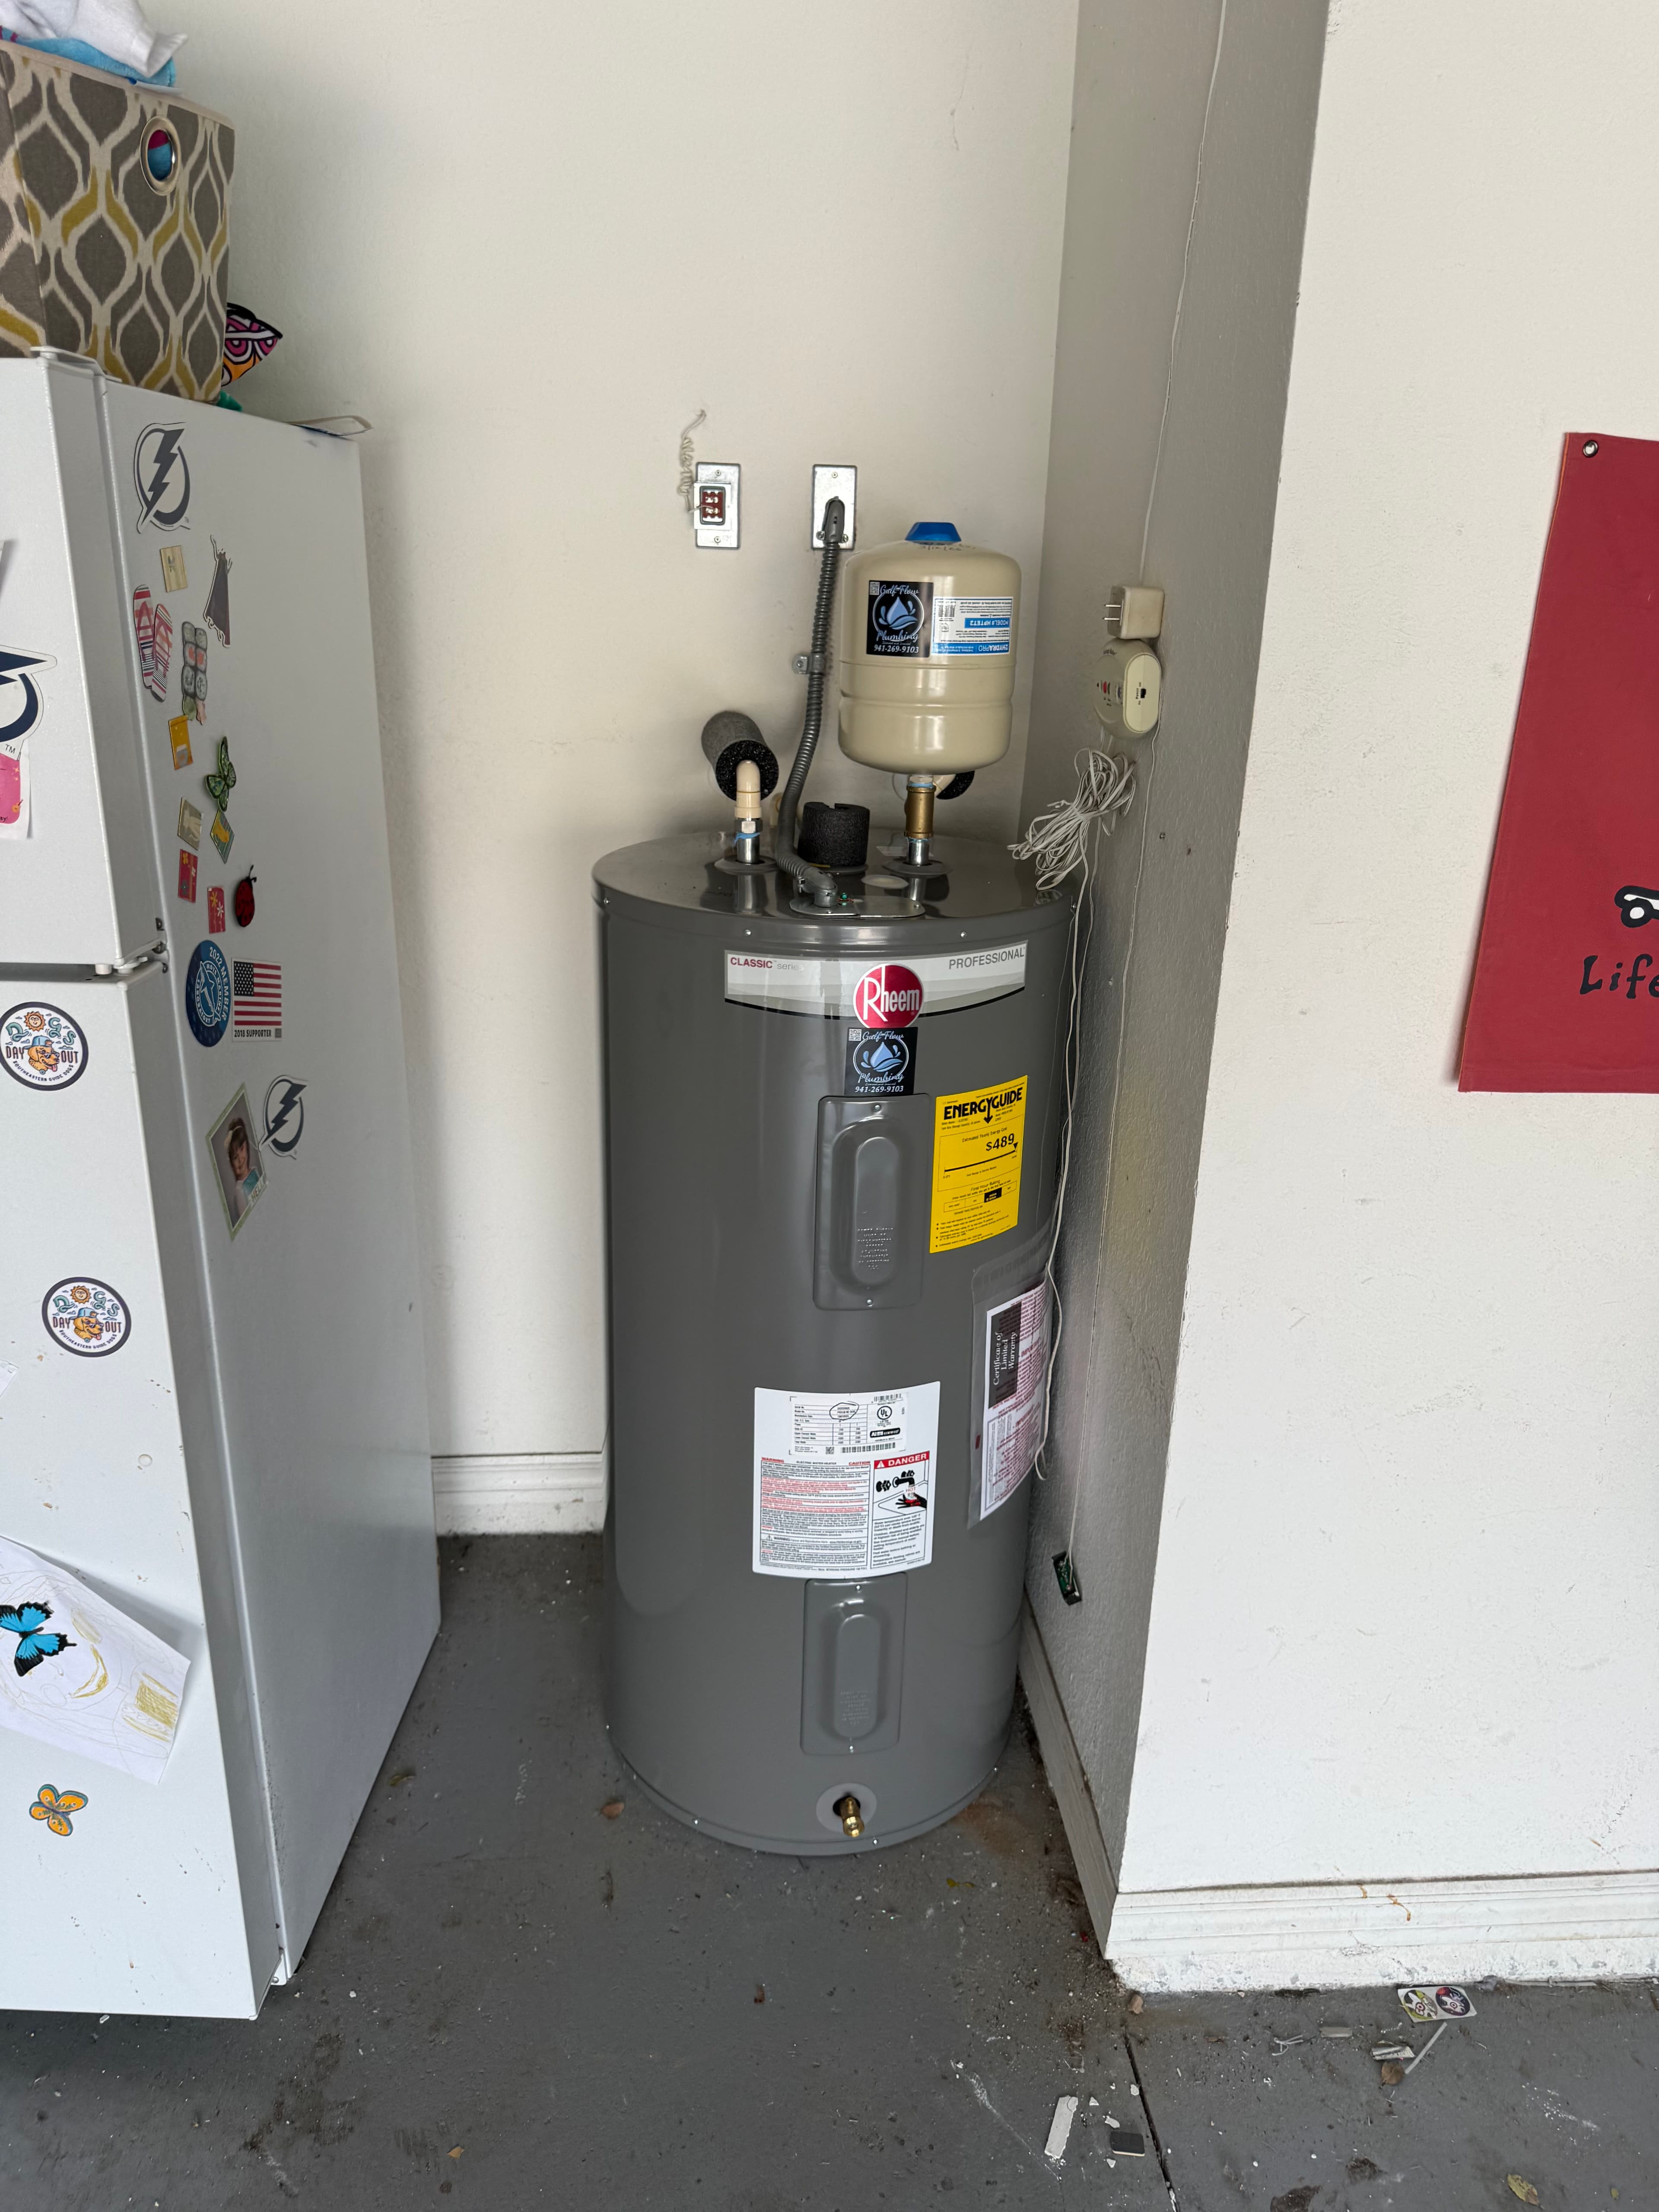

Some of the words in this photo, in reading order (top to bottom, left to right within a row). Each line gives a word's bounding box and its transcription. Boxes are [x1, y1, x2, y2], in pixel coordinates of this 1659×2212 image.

[876, 629, 919, 643] Plumbing
[874, 644, 919, 654] 941-269-9103
[731, 957, 772, 968] CLASSIC
[949, 947, 1024, 969] PROFESSIONAL
[210, 947, 222, 967] 2022
[221, 966, 229, 1021] MEMBER
[863, 966, 919, 1022] Rheem
[246, 1029, 271, 1037] SUPPORTER
[6, 1046, 25, 1059] DAY
[61, 1050, 79, 1064] OUT
[858, 1071, 904, 1083] Plumbing
[944, 1087, 1023, 1120] ENERGYGUIDE
[986, 1133, 1014, 1151] $489
[53, 1316, 70, 1329] DAY
[105, 1321, 122, 1333] OUT
[1008, 1332, 1017, 1369] Warranty
[888, 1453, 927, 1466] DANGER
